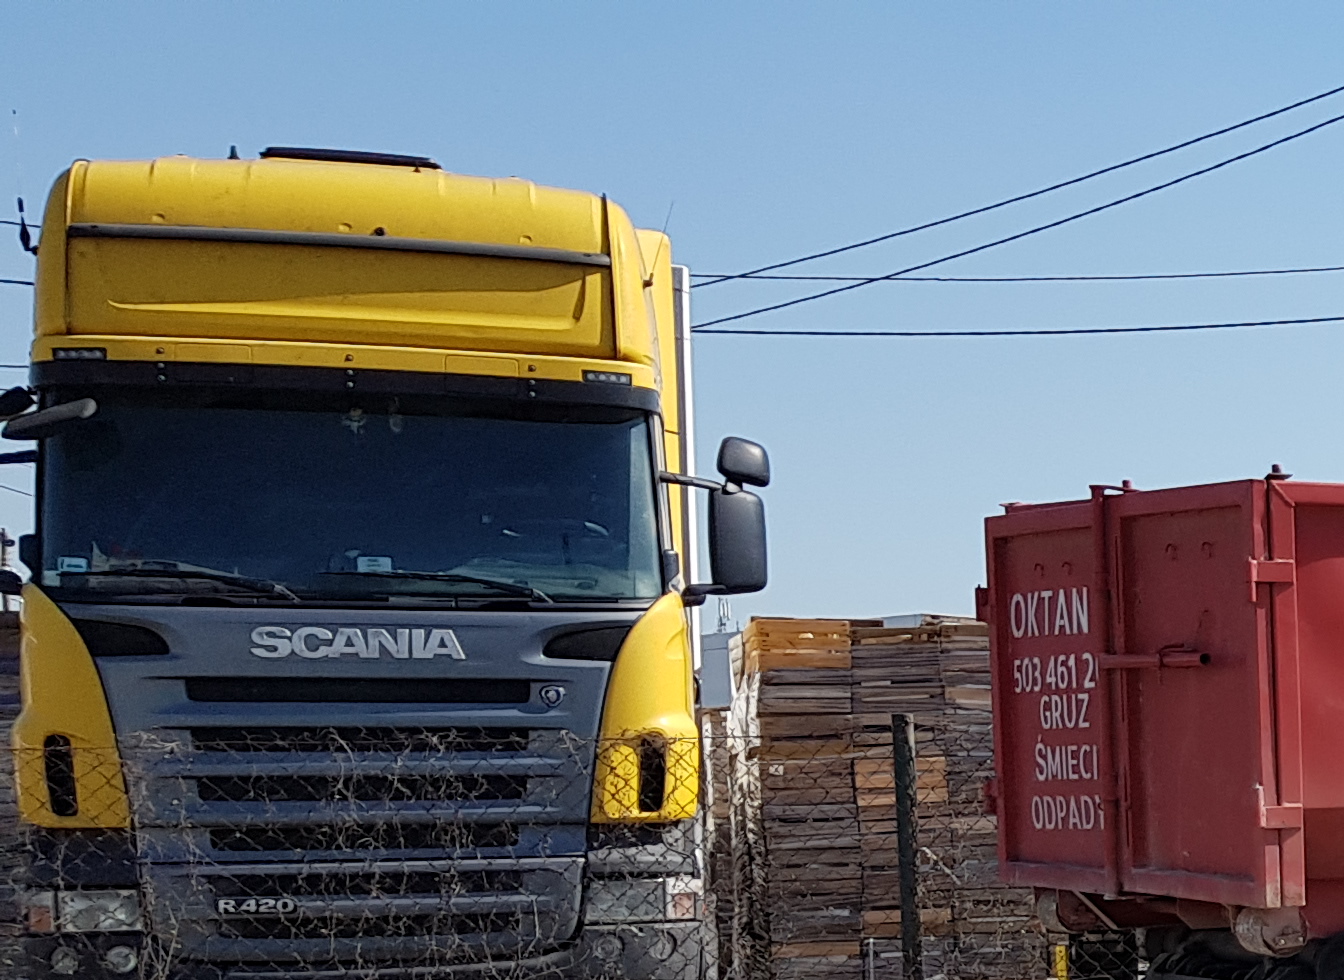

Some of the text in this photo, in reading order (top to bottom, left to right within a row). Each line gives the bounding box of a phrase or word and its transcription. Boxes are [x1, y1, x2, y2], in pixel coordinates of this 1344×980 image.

[1010, 587, 1089, 639] OKTAN
[250, 626, 466, 661] SCANIA
[1014, 657, 1042, 694] 503
[1046, 654, 1077, 691] 461
[1040, 693, 1090, 730] GRUZ
[1035, 734, 1098, 782] ŚMIECI
